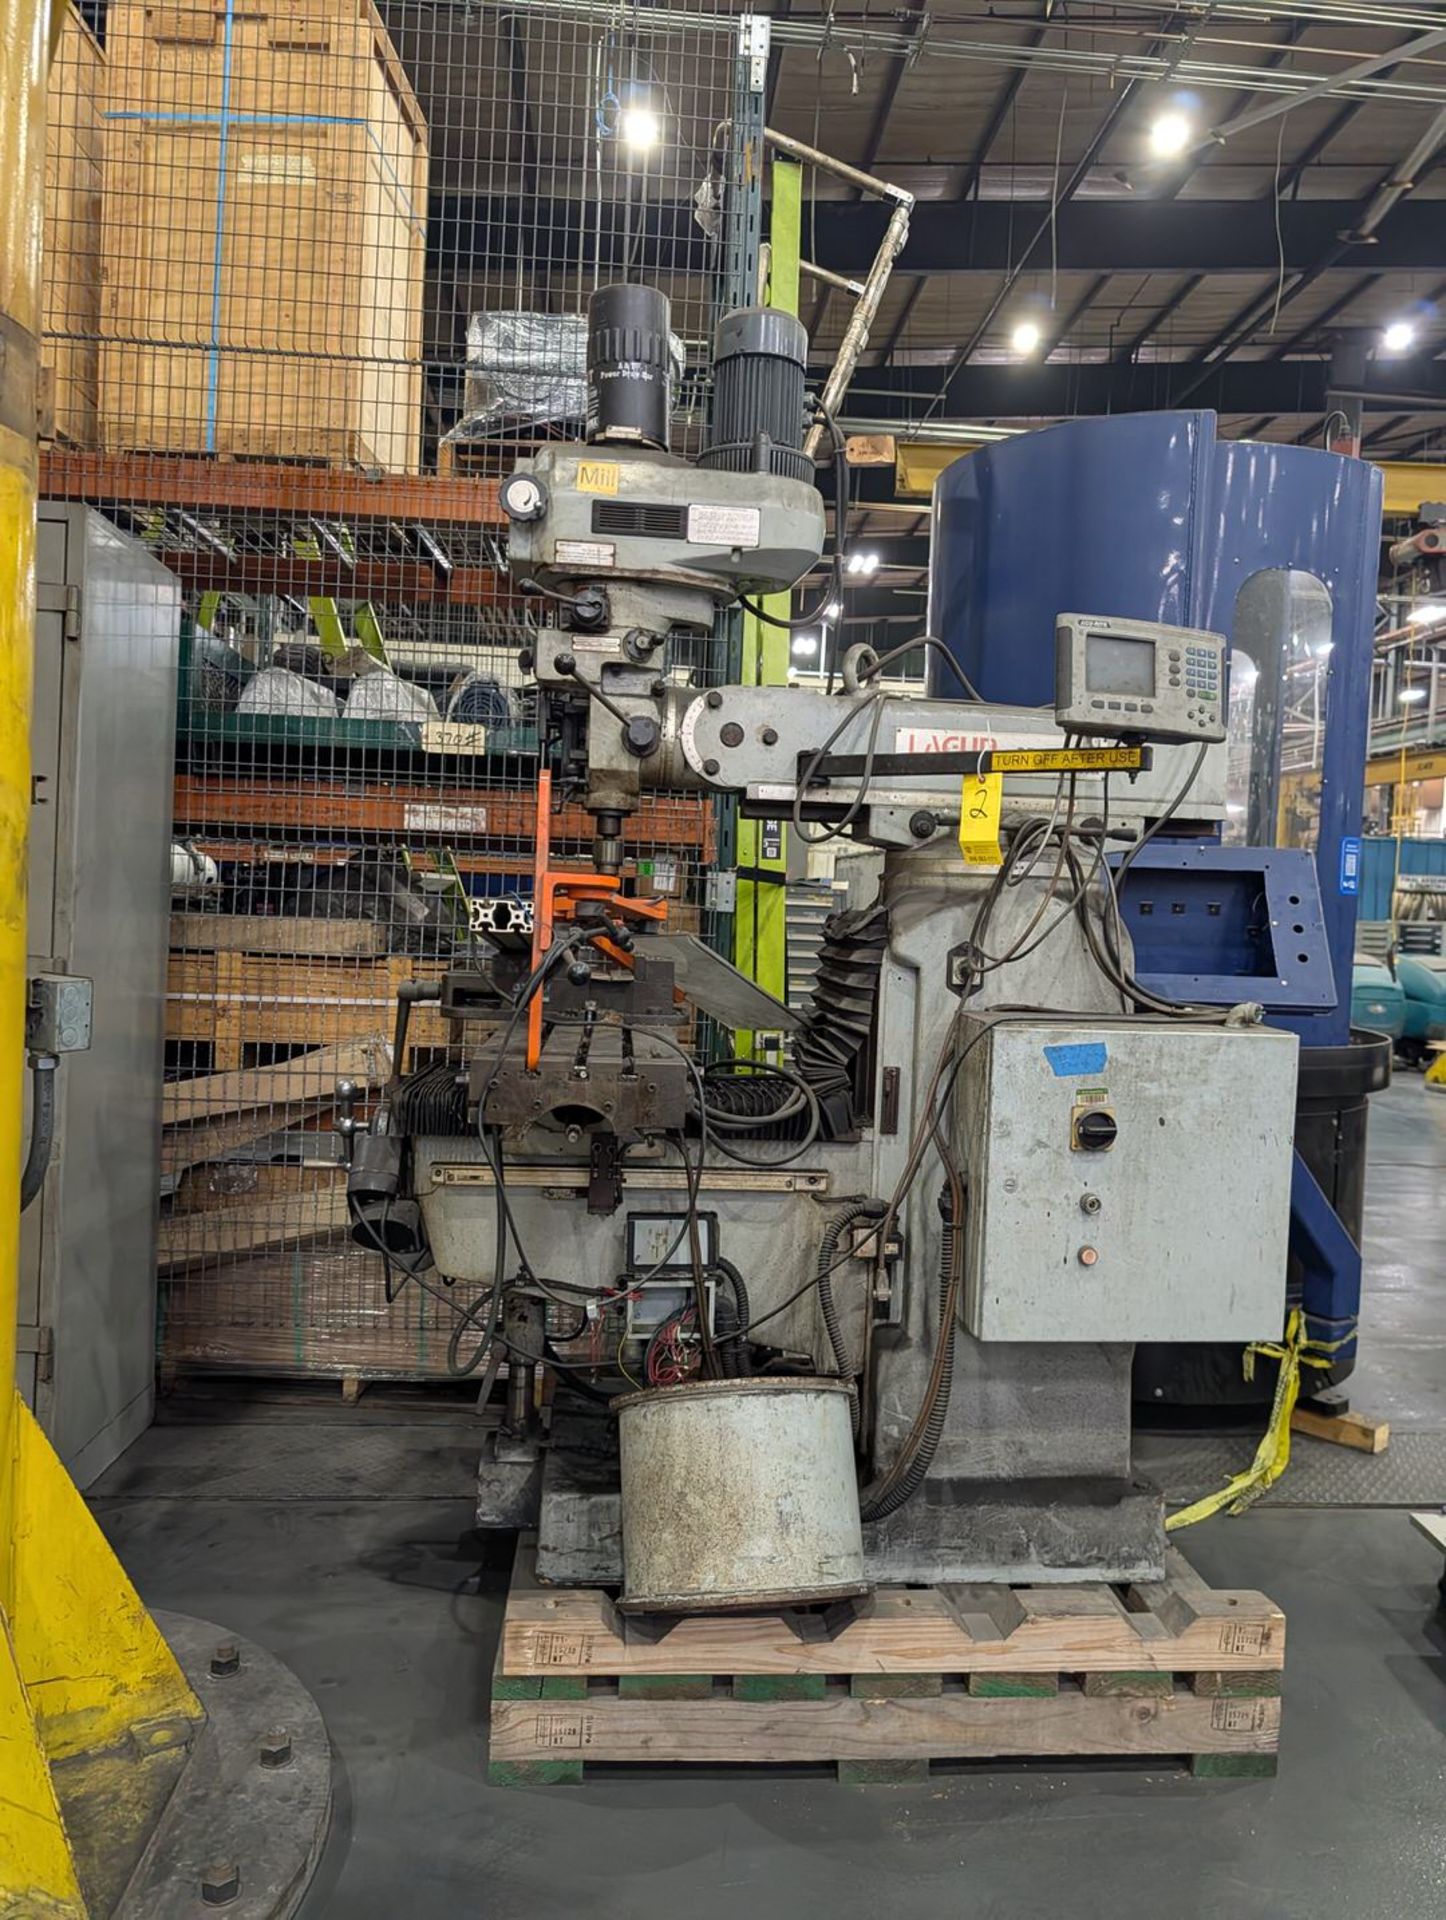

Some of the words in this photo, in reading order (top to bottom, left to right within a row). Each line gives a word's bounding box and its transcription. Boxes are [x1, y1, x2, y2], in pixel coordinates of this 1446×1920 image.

[579, 466, 616, 487] Mill
[994, 754, 1030, 767] TURN
[1033, 753, 1058, 766] OFF
[1062, 752, 1105, 765] AFTER
[1110, 751, 1137, 763] USE
[969, 788, 988, 819] 2
